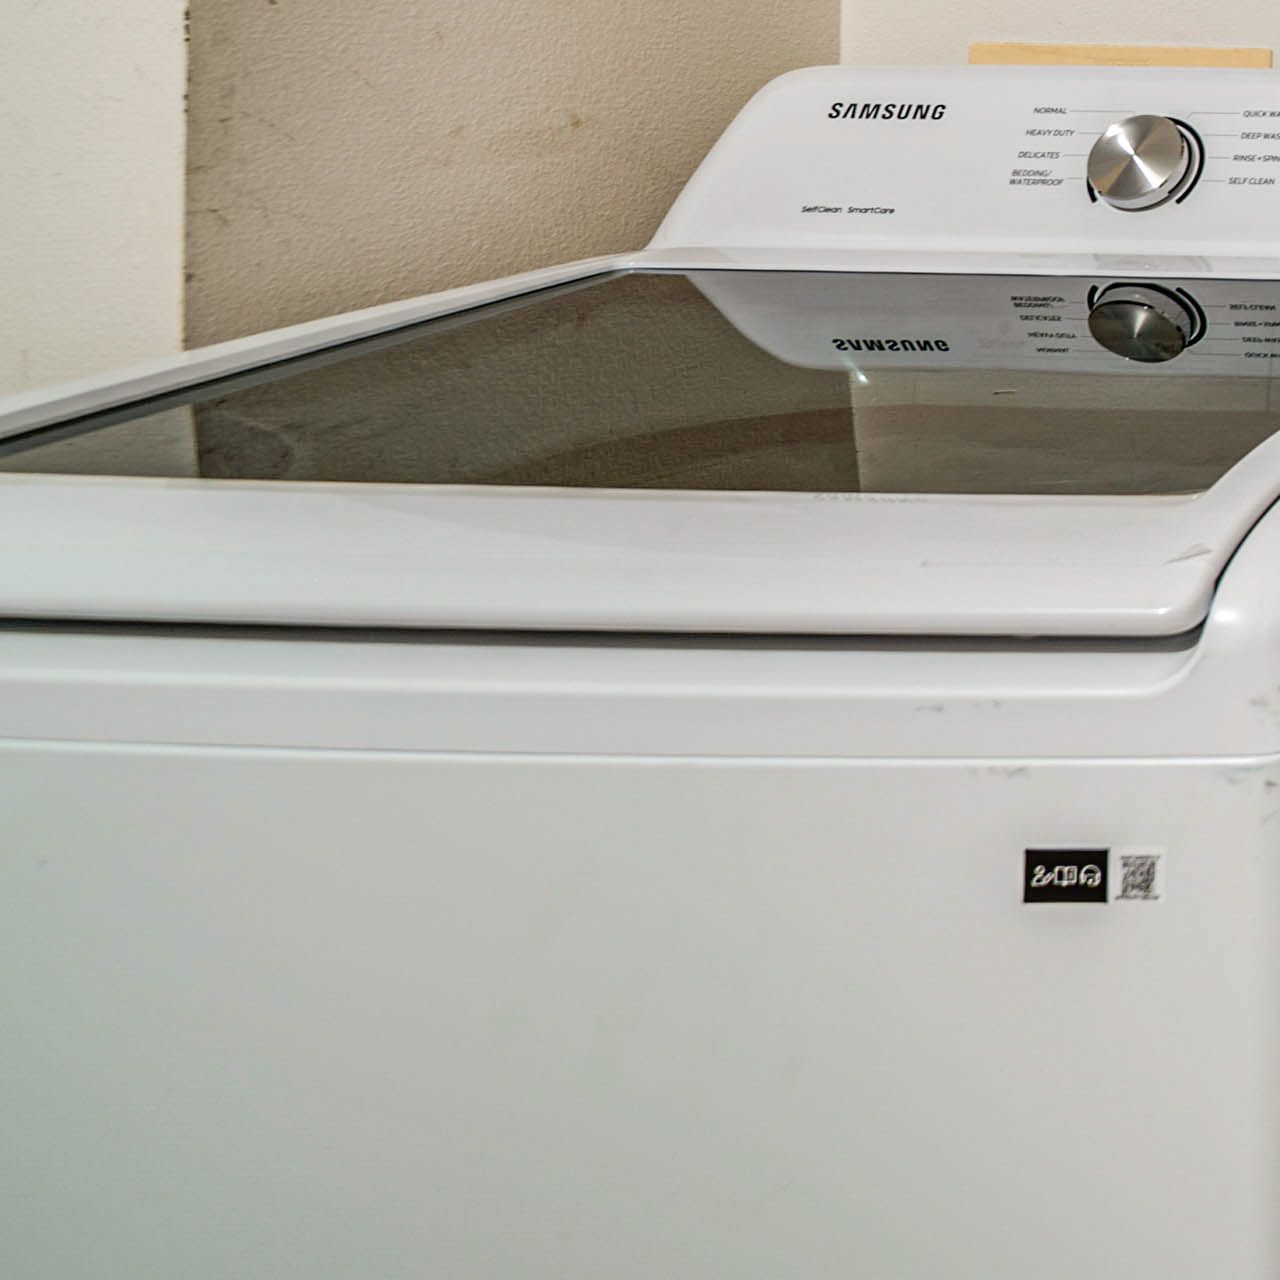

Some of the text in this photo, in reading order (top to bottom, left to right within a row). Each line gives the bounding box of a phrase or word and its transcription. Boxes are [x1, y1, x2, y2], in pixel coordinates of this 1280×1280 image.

[828, 103, 947, 120] SAMSUNG
[1033, 107, 1068, 115] NORMAL
[1243, 110, 1269, 118] QUICK
[1025, 129, 1075, 137] HEAVY DUTY
[1240, 132, 1263, 140] DEEP
[1017, 151, 1061, 159] DELICATES
[1009, 178, 1065, 186] WATERPROOF
[1228, 177, 1276, 185] SELF CLEAN
[847, 206, 896, 214] SmartCare
